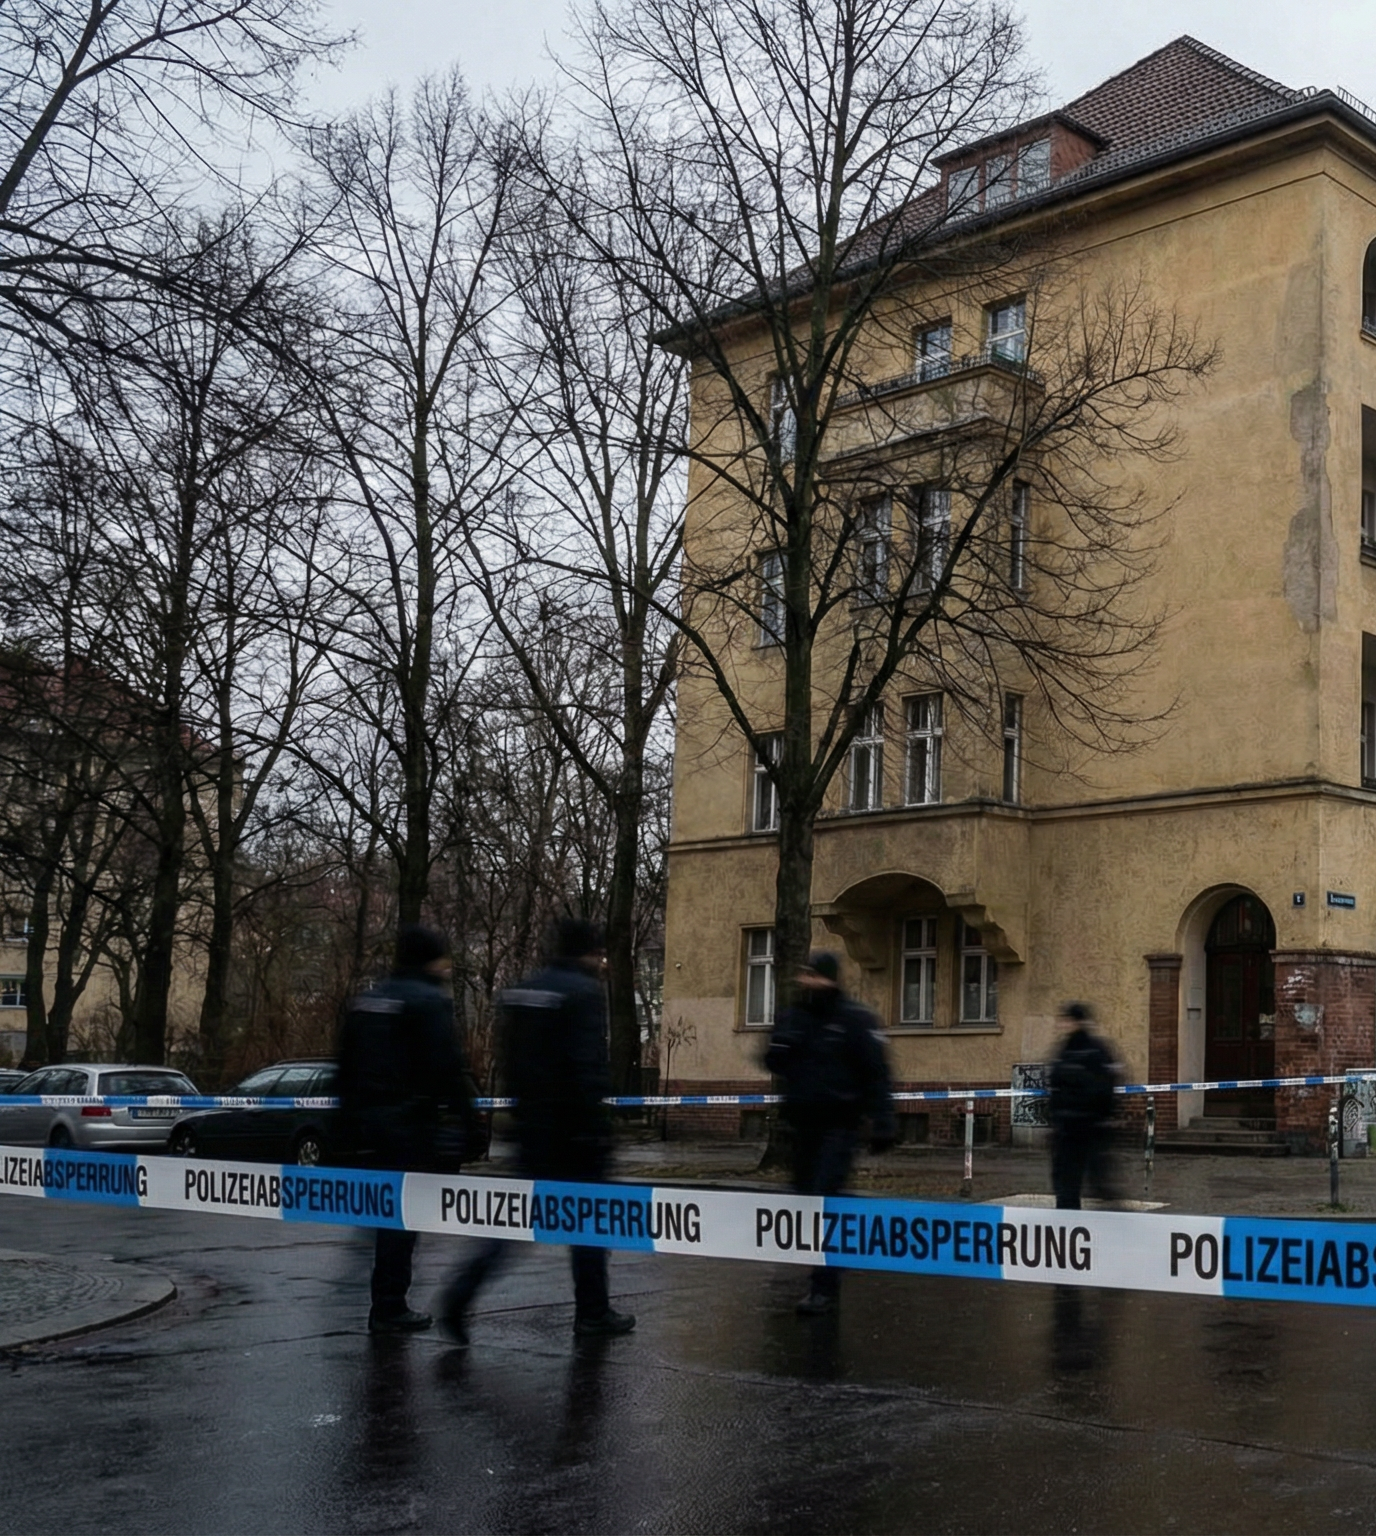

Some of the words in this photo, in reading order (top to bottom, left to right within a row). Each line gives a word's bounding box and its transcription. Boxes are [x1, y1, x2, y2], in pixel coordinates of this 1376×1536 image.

[0, 1156, 148, 1197] IZEIABSPERRUNG
[185, 1169, 395, 1218] POLIZEIABSPERRUNG
[441, 1187, 701, 1243] POLIZEIABSPERRUNG
[756, 1208, 1092, 1271] POLIZEIABSPERRUNG
